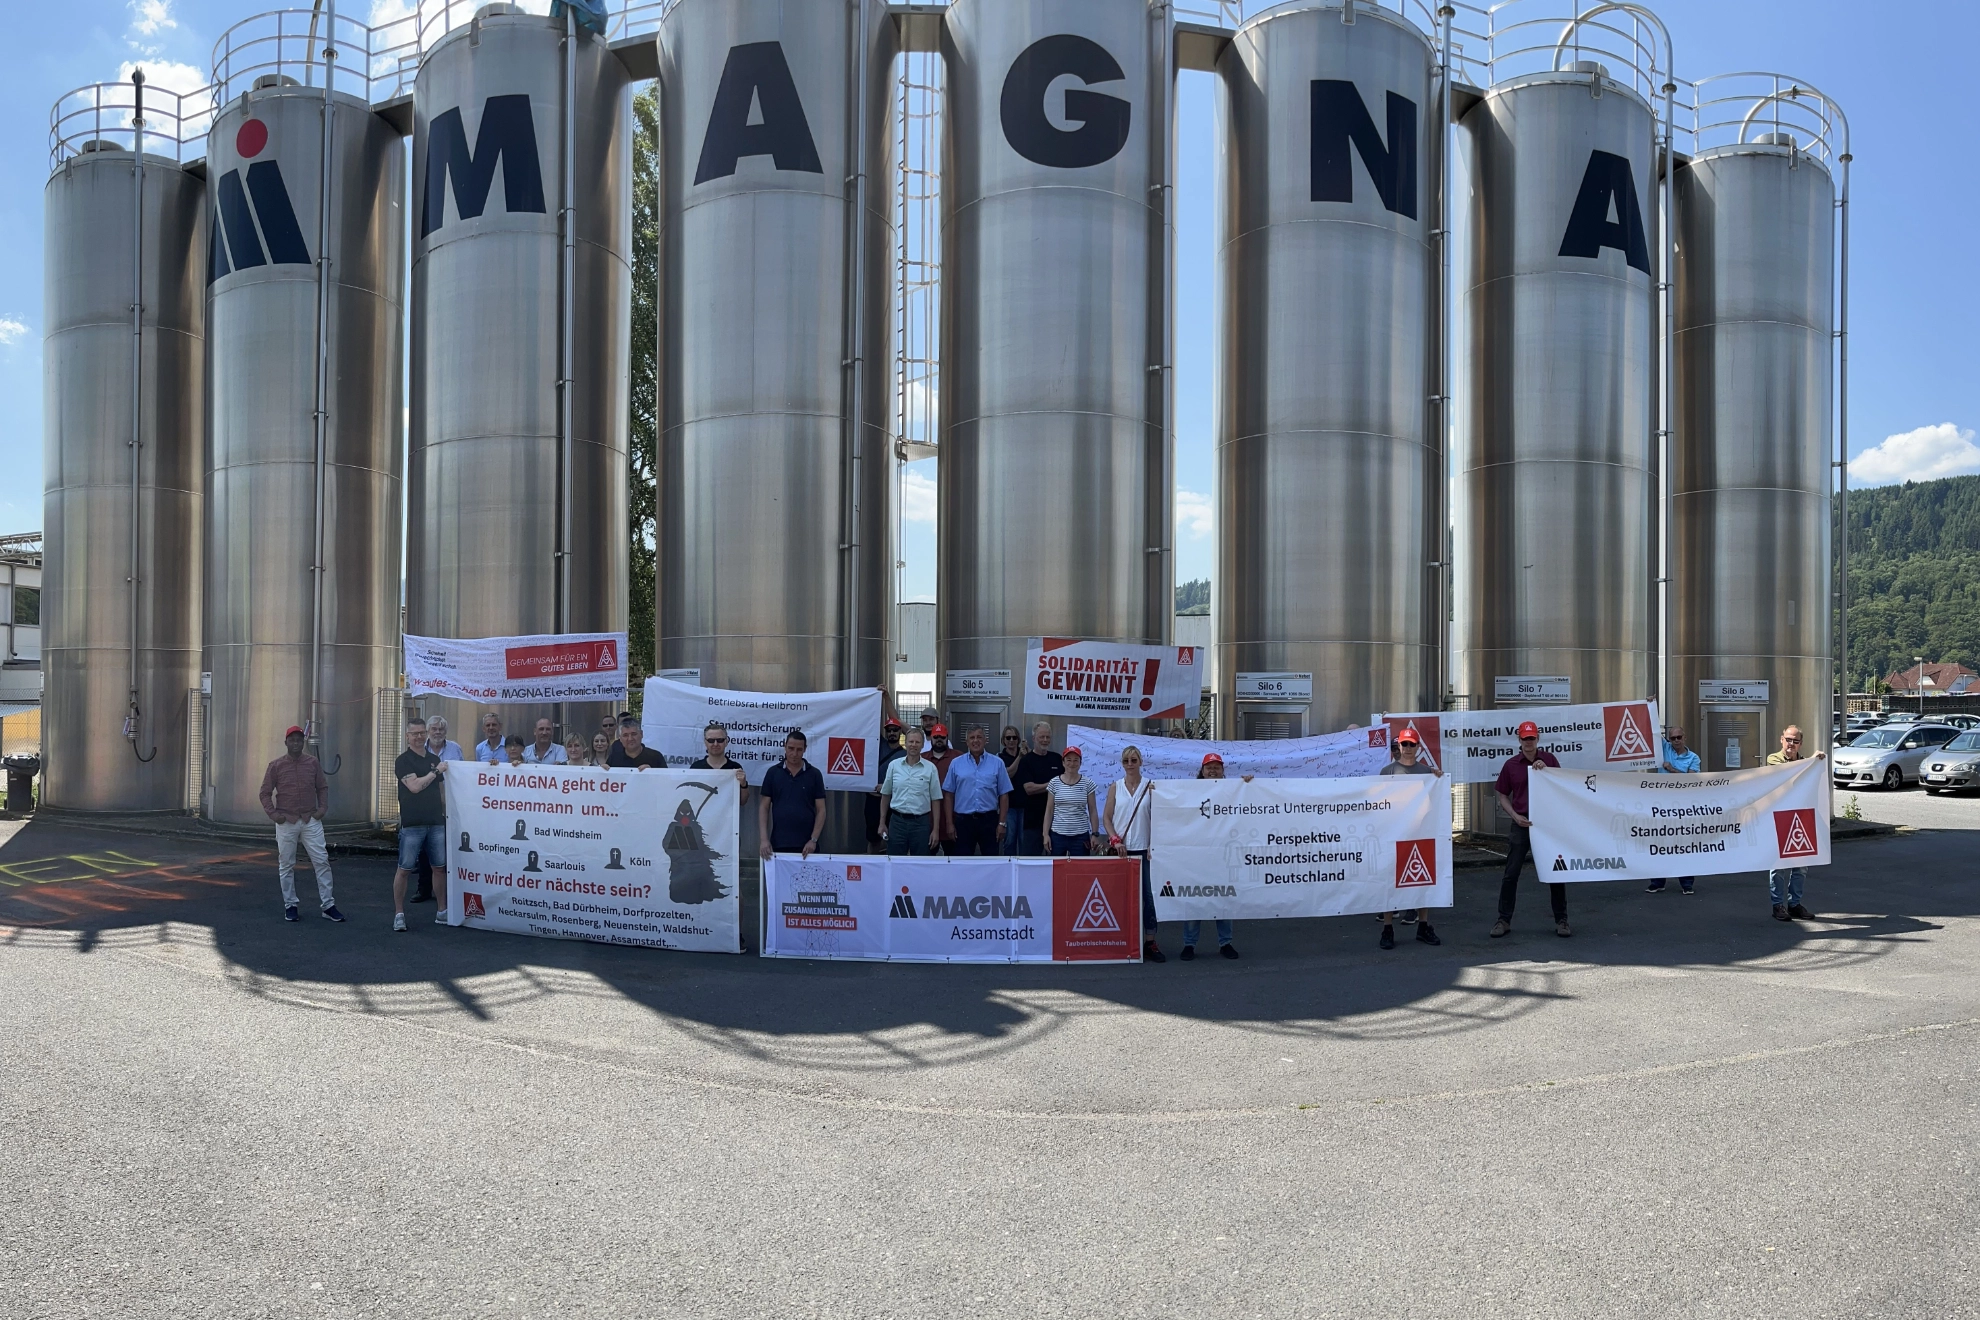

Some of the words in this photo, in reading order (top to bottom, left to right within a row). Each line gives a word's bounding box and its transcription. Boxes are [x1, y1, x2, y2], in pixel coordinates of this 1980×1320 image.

[509, 654, 559, 667] GEMEINSAM
[560, 653, 575, 662] FÜR
[576, 653, 588, 661] EIN
[541, 663, 565, 673] GUTES
[567, 661, 589, 671] LEBEN
[1038, 655, 1139, 675] SOLIDARITÄT
[962, 680, 976, 689] Silo
[978, 680, 984, 689] 5
[1257, 681, 1275, 691] Silo
[1276, 681, 1283, 691] 6
[1518, 684, 1535, 693] Silo
[1537, 684, 1543, 693] 7
[1721, 687, 1738, 695] Silo
[1739, 687, 1745, 695] 8
[501, 687, 543, 699] MAGNA
[708, 697, 759, 708] Betriebsrat
[761, 700, 808, 711] Heilbronn
[1444, 728, 1459, 739] IG
[1462, 726, 1501, 738] Metall
[761, 751, 776, 761] für
[1467, 745, 1514, 759] Magna
[478, 772, 500, 787] Bei
[504, 774, 558, 790] MAGNA
[561, 777, 596, 794] geht
[600, 778, 627, 793] der
[1640, 780, 1704, 789] Betriebsrat
[1705, 778, 1730, 787] Köln
[482, 796, 573, 815] Sensenmann
[1213, 803, 1280, 816] Betriebsrat
[1283, 799, 1391, 816] Untergruppenbach
[1651, 804, 1723, 820] Perspektive
[534, 827, 551, 838] Bad
[552, 828, 602, 840] Windsheim
[1630, 820, 1741, 838] Standortsicherung
[1267, 831, 1341, 846] Perspektive
[478, 842, 520, 856] Bopfingen
[1649, 839, 1725, 856] Deutschland
[629, 857, 651, 867] Köln
[1244, 849, 1363, 866] Standortsicherung
[1569, 856, 1627, 871] MAGNA
[544, 860, 586, 872] Saarlouis
[457, 867, 481, 882] Wer
[484, 871, 513, 887] wird
[516, 874, 542, 890] der
[545, 877, 606, 896] nächste
[609, 882, 652, 899] sein?
[1264, 868, 1345, 885] Deutschland
[1177, 884, 1237, 897] MAGNA
[799, 895, 821, 903] WENN
[821, 895, 836, 903] WIR
[511, 896, 551, 910] Roitzsch,
[552, 901, 570, 911] Bad
[572, 902, 621, 917] Dürbheim,
[623, 907, 694, 921] Dorfprozelten,
[784, 905, 848, 916] ZUSAMMENHALTEN
[922, 895, 1033, 919] MAGNA
[498, 906, 550, 923] Neckarsulm,
[551, 913, 602, 930] Rosenberg,
[603, 919, 661, 934] Neuenstein,
[662, 923, 713, 936] Waldshut-
[787, 917, 799, 926] IST
[800, 918, 821, 927] ALLES
[823, 917, 855, 928] MÖGLICH
[950, 925, 1035, 940] Assamstadt
